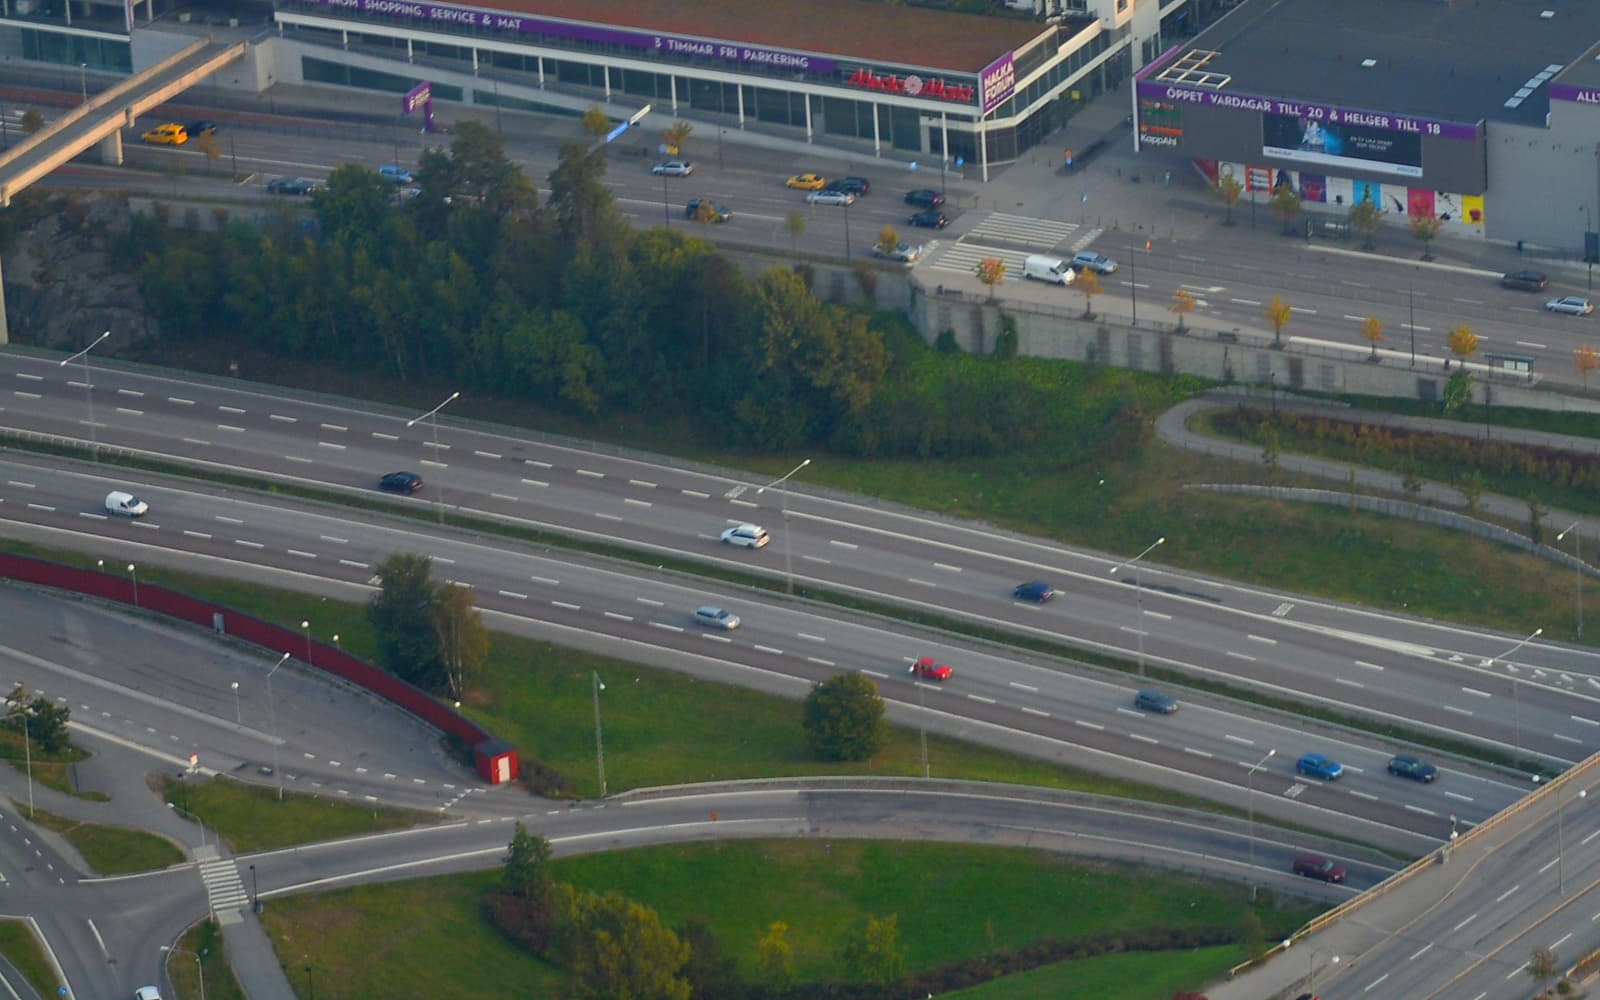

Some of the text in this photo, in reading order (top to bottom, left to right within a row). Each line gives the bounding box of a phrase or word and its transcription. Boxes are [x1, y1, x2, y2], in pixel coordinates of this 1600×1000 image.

[431, 7, 476, 23] SERVICE
[482, 14, 491, 25] &
[497, 17, 522, 30] MAT
[654, 37, 809, 68] 3 TIMMAR FRI PARKERING
[984, 61, 1015, 90] NACKA
[984, 73, 1015, 103] FORUM
[1166, 86, 1441, 134] ÖPPET VARDAGAR TILL 20 & HELGER TILL 18
